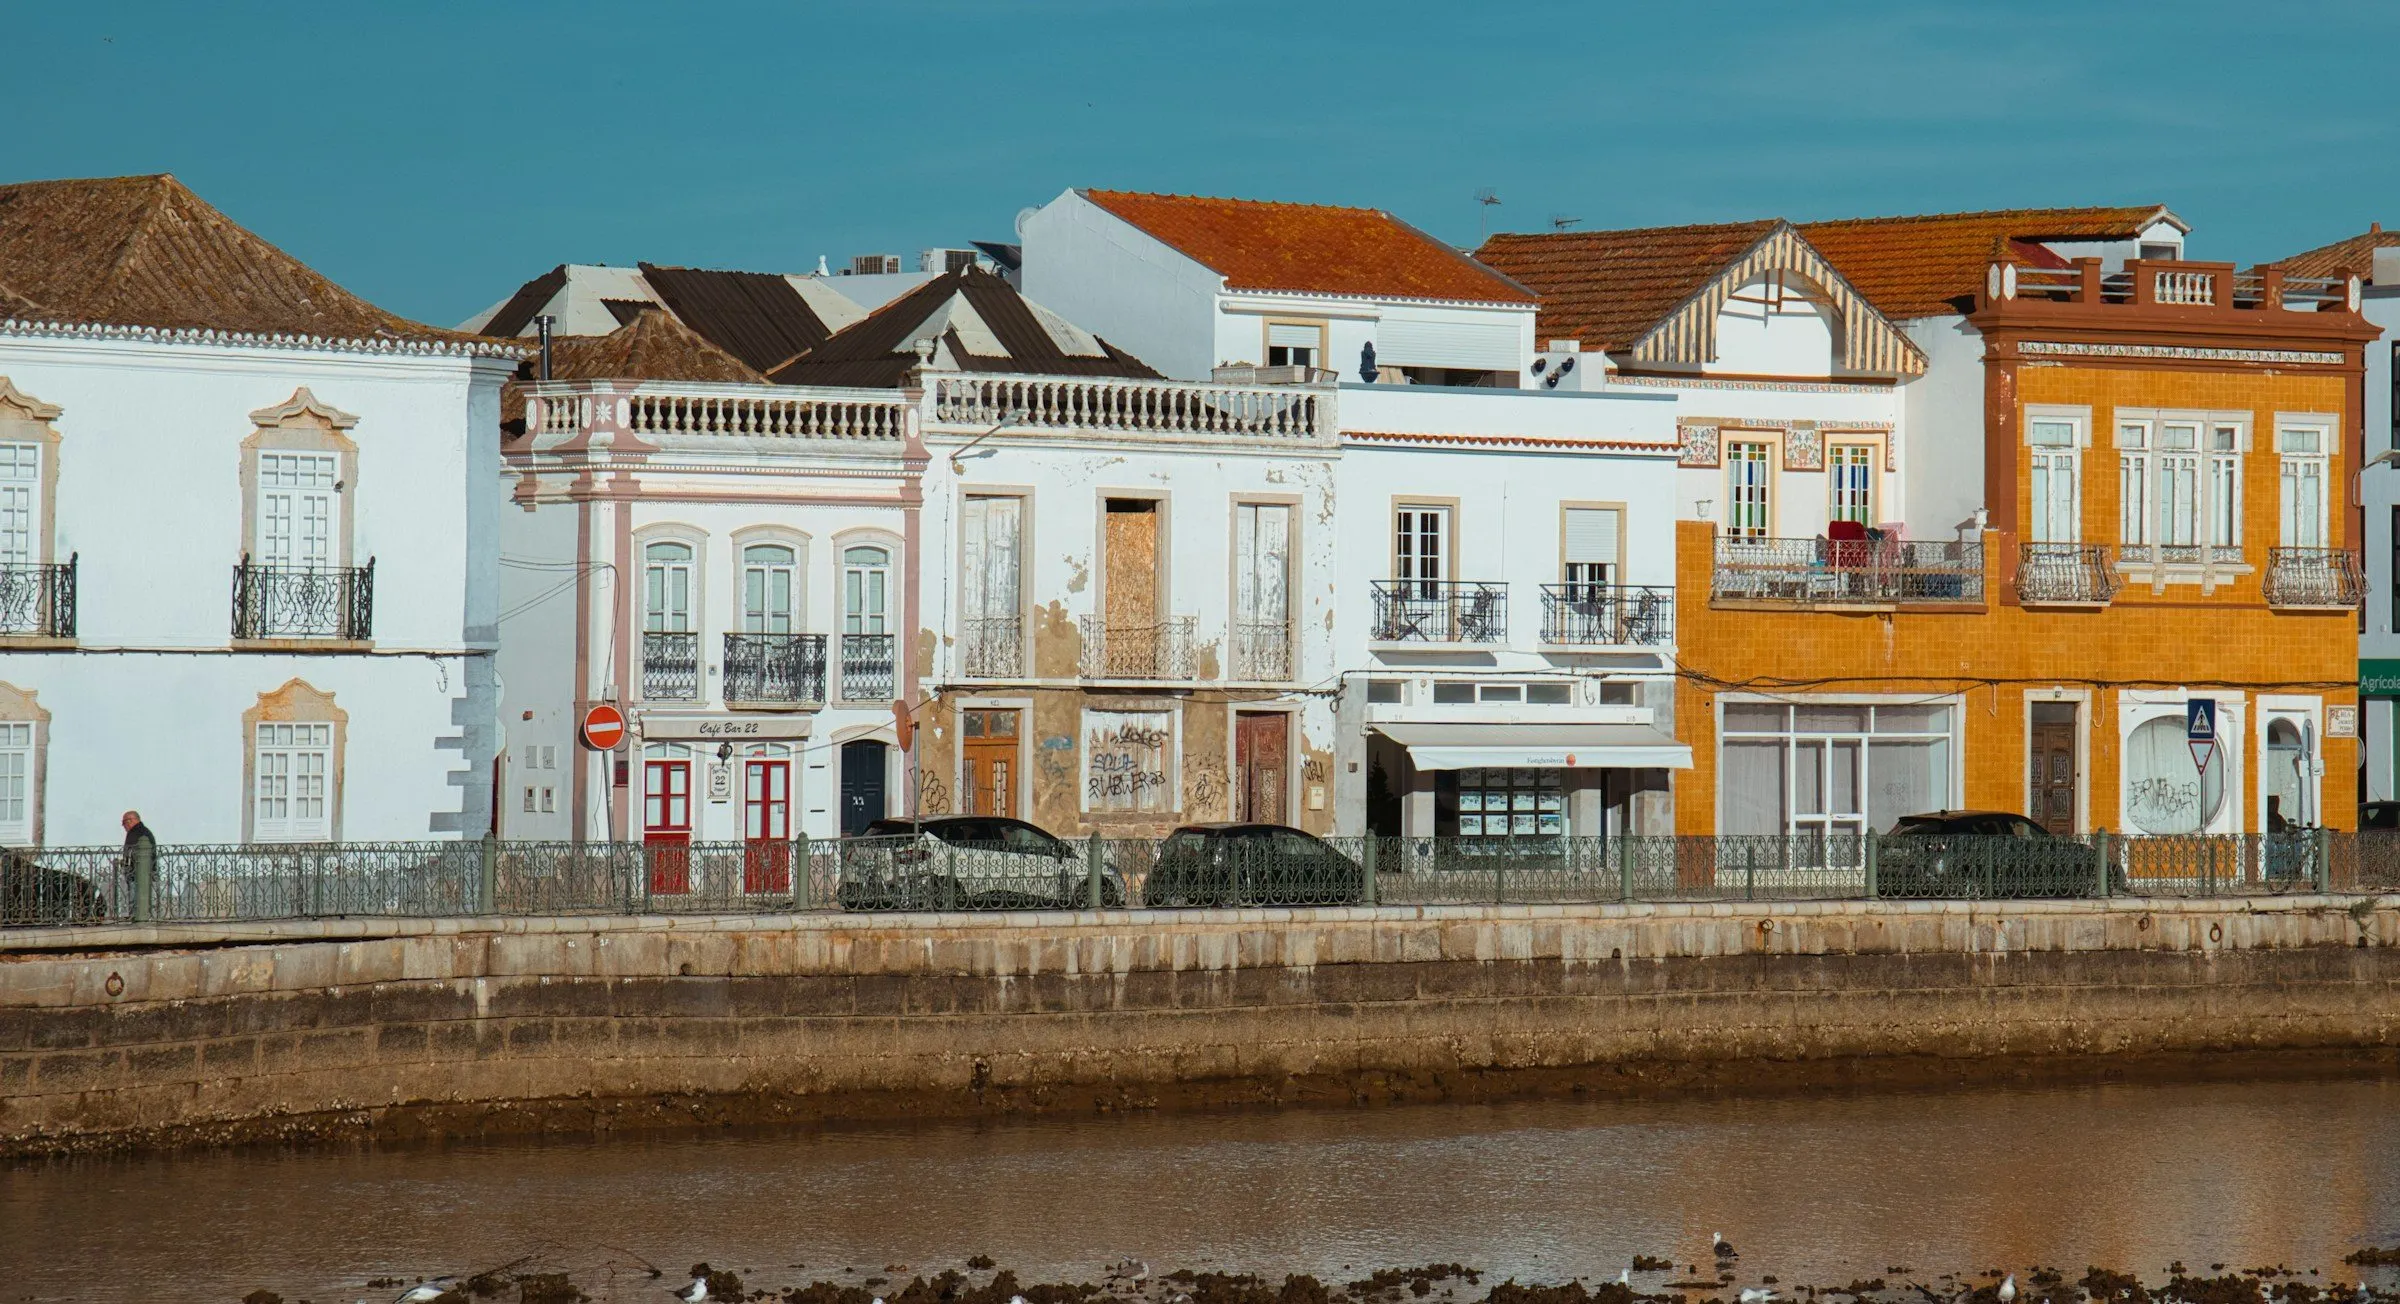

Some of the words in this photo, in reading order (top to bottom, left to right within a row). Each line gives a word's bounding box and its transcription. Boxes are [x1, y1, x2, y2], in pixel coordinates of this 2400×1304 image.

[700, 722, 720, 736] Café
[724, 722, 742, 733] Bar
[744, 723, 759, 733] 22
[714, 775, 726, 785] 22
